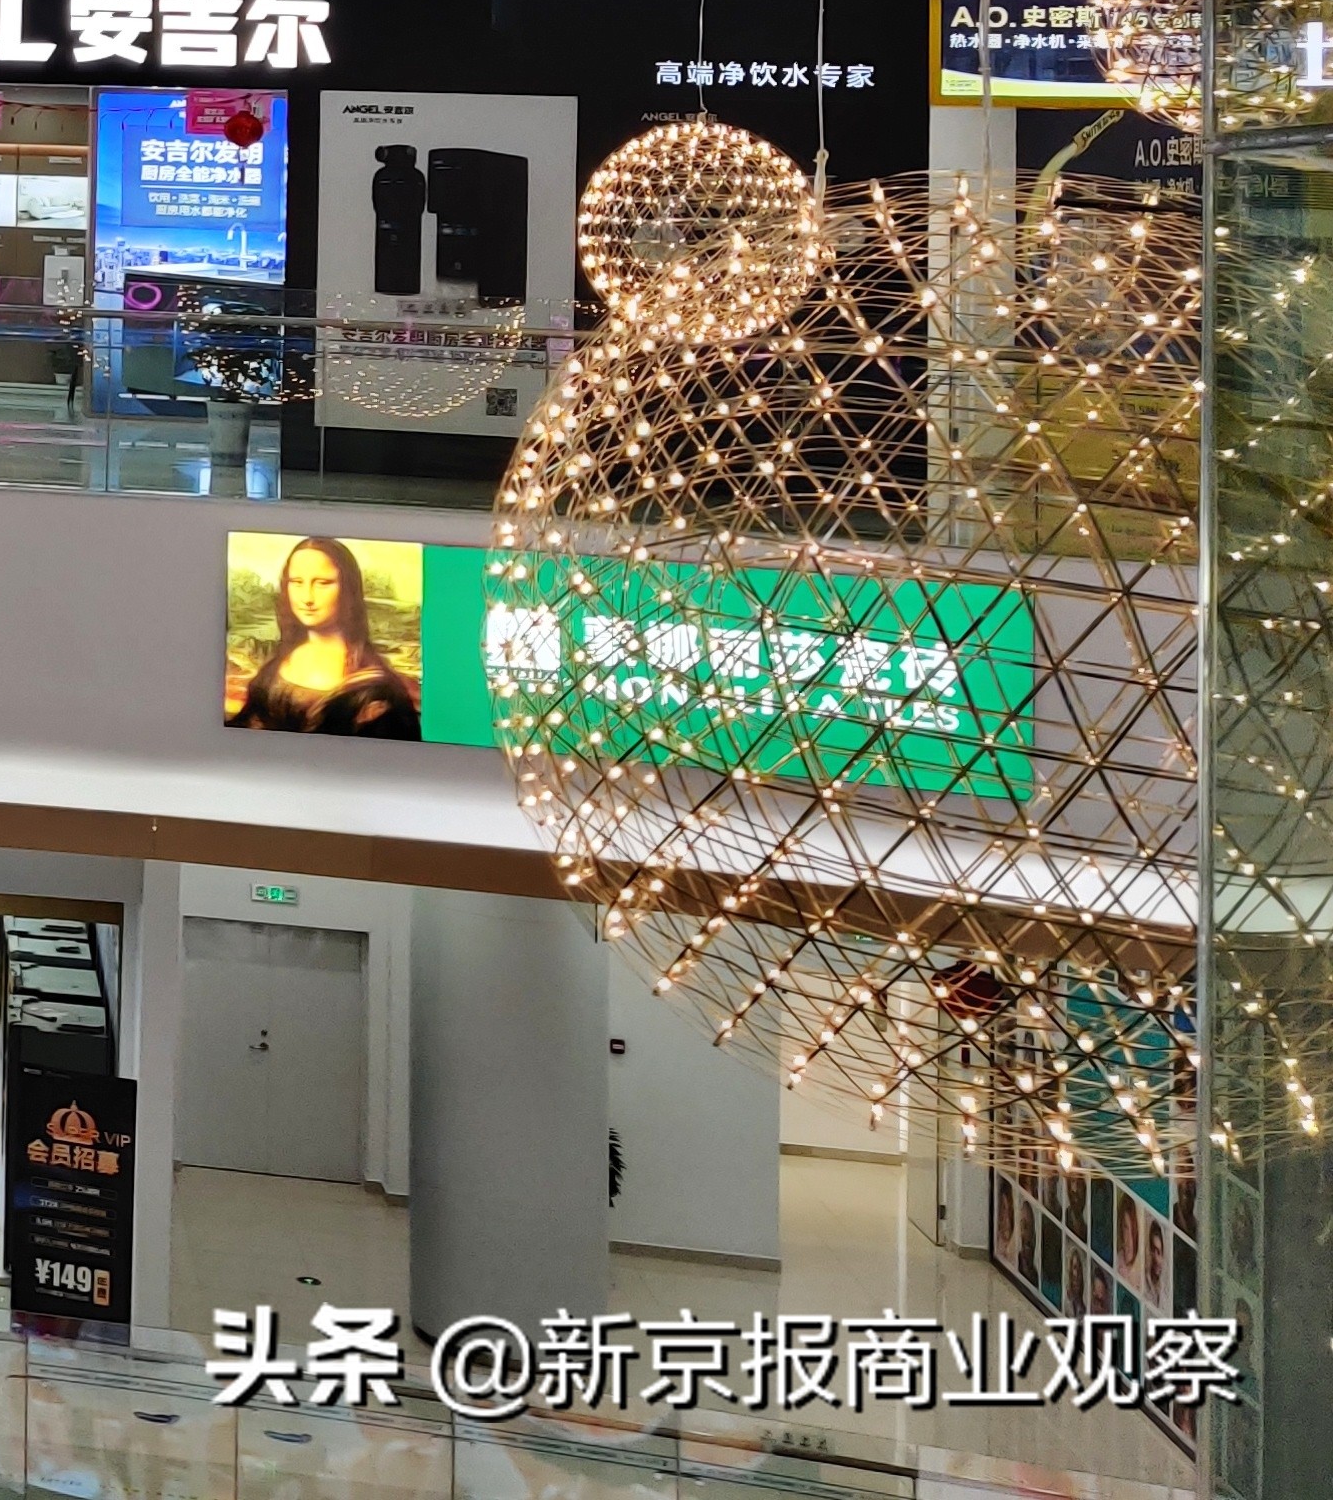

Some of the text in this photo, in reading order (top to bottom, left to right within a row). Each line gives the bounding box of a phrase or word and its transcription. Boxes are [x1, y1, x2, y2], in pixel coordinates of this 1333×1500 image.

[654, 60, 877, 88] 高端净饮水专家
[639, 112, 683, 122] ANGEL
[140, 138, 264, 165] 安吉尔发明
[140, 164, 262, 185] 厨房全能净水器
[103, 1131, 132, 1147] VIP
[26, 1138, 120, 1175] 会员招募
[34, 1257, 93, 1293] ¥149
